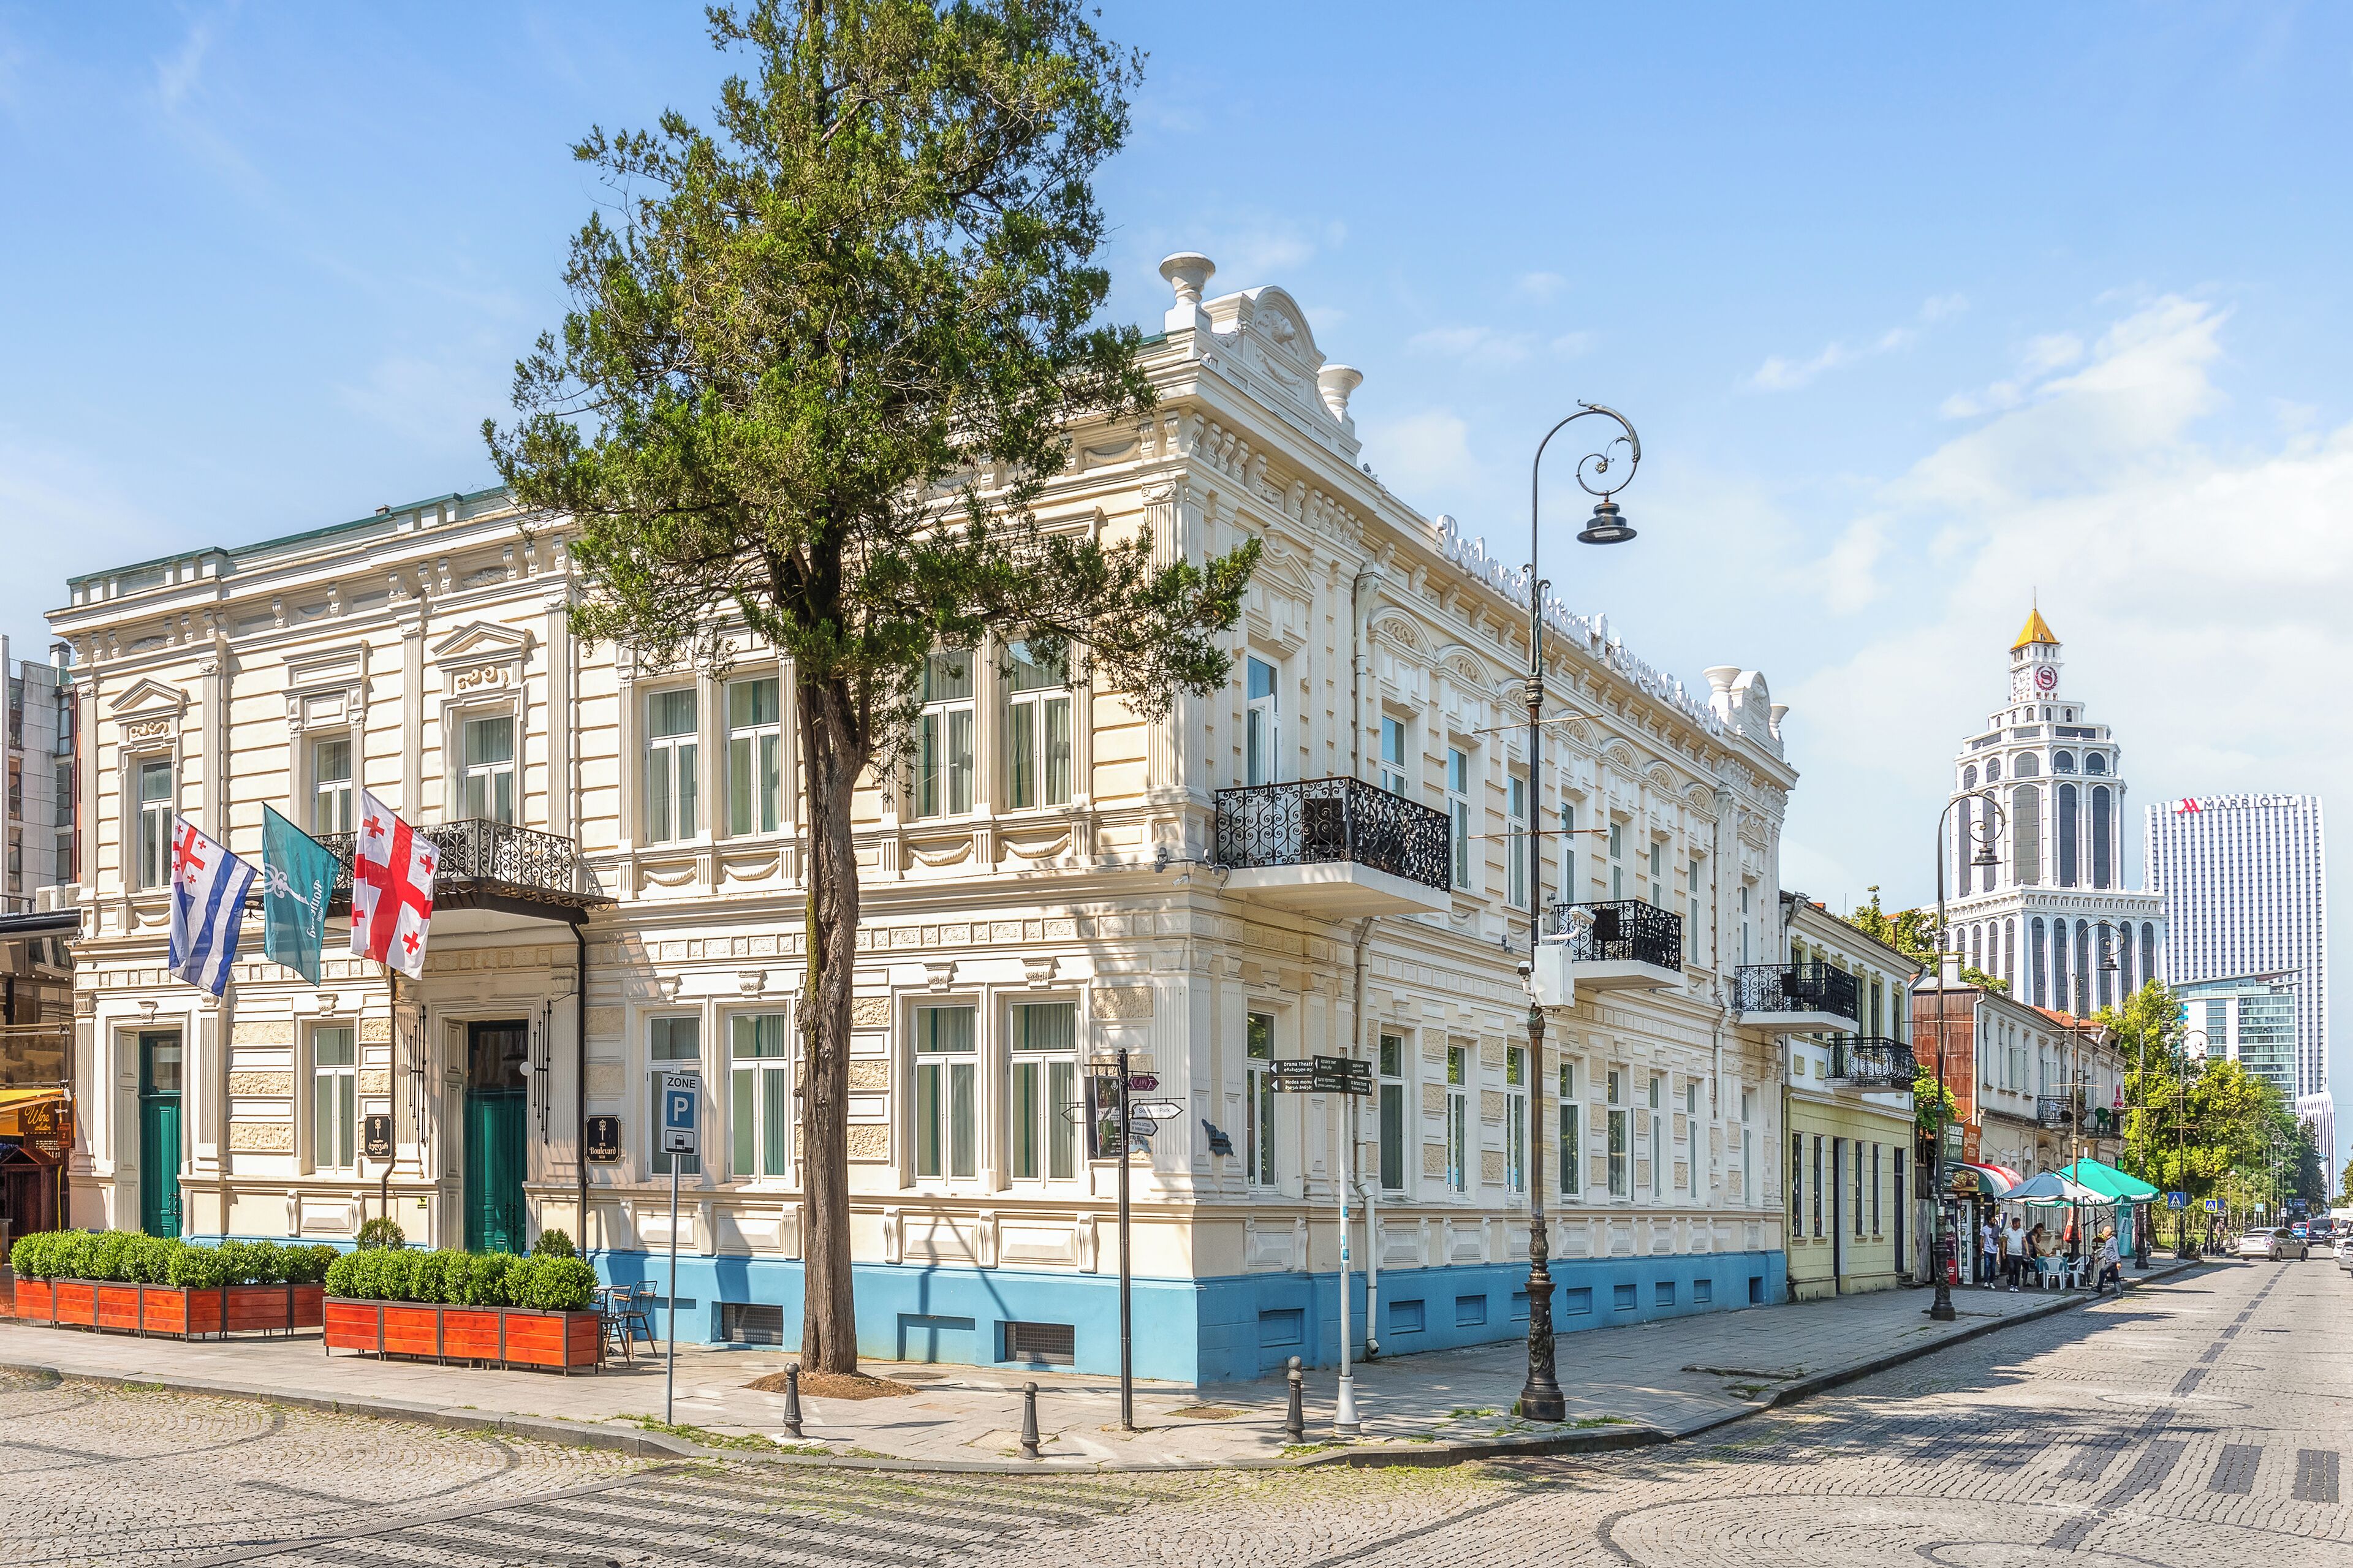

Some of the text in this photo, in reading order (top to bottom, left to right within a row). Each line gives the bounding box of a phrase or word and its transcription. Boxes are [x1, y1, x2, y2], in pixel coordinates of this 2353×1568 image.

[2040, 670, 2052, 684] S
[2204, 796, 2293, 810] MARRIOTT
[667, 1077, 696, 1088] ZONE
[25, 1102, 50, 1124] Wine
[673, 1096, 689, 1121] P
[589, 1146, 616, 1155] Boulevard
